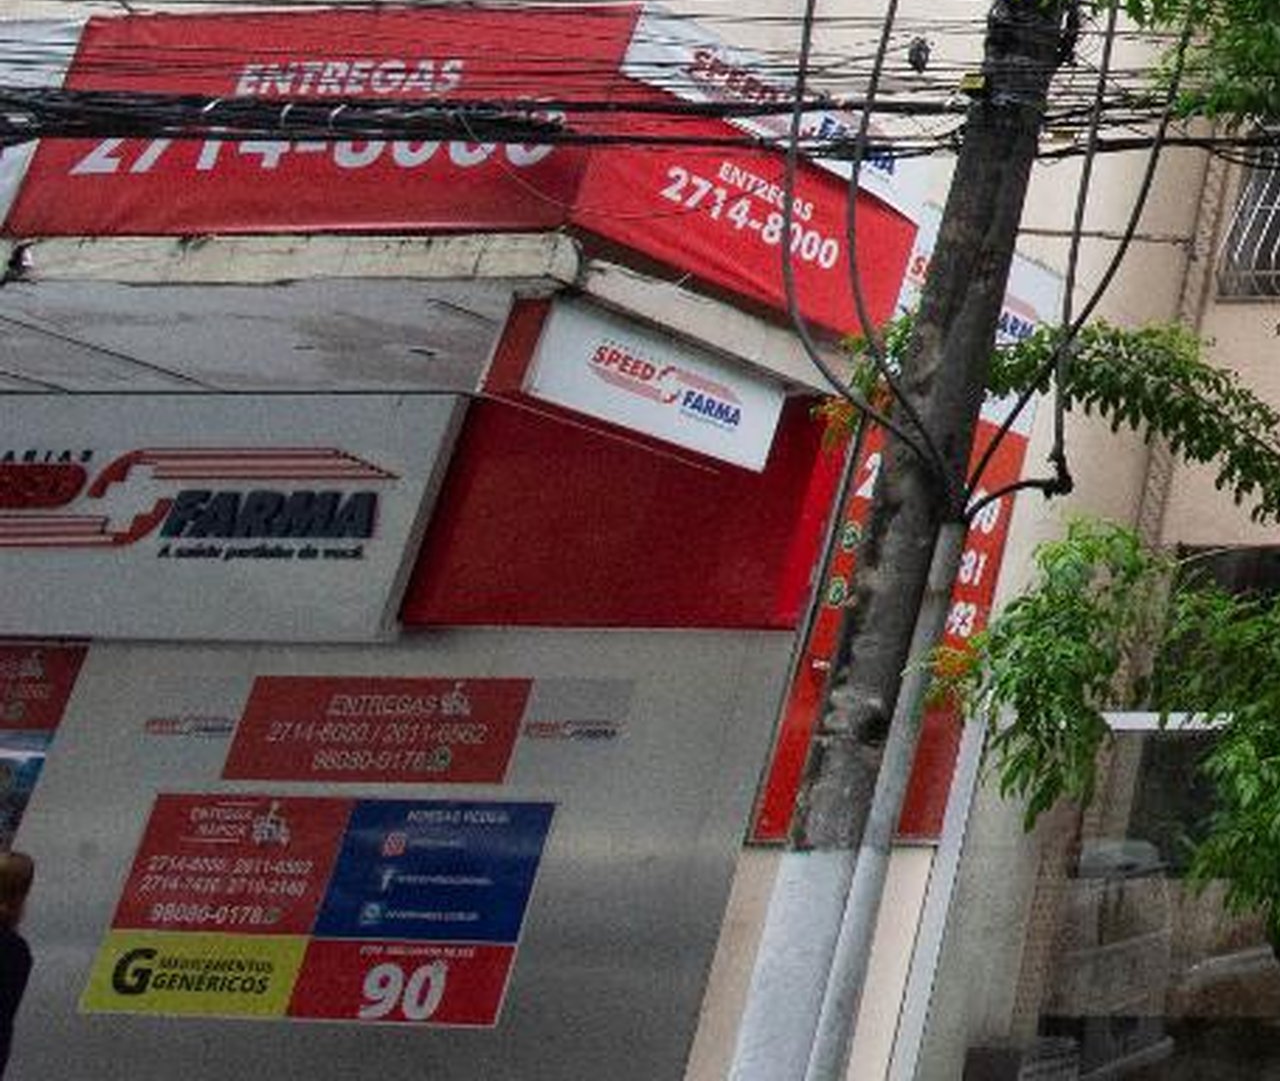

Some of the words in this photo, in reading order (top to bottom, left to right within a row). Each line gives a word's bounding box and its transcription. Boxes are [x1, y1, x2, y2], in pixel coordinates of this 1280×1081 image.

[235, 60, 463, 97] ENTREGAS
[592, 346, 656, 381] SPEED
[682, 390, 741, 426] FARMA
[160, 490, 379, 539] FARMA
[326, 694, 437, 716] ENTREGAS
[112, 948, 158, 995] G
